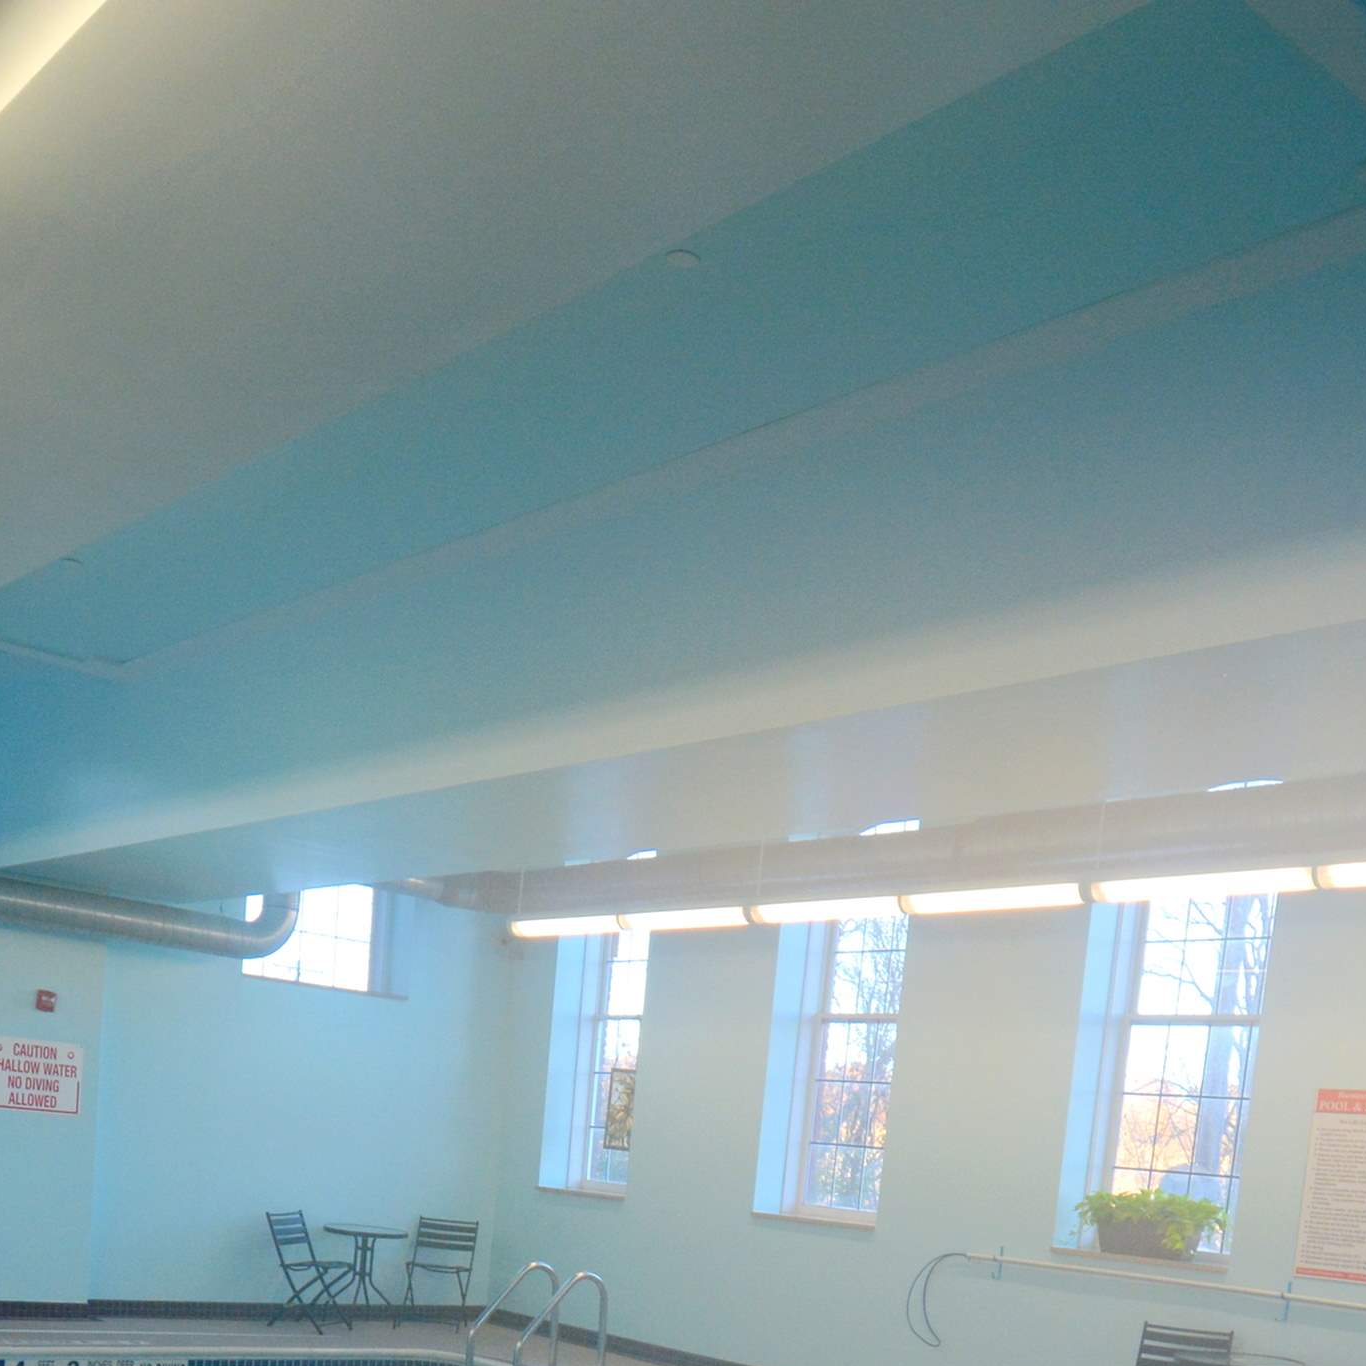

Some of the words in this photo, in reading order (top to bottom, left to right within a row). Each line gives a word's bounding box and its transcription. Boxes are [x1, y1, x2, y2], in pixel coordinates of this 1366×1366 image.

[13, 1042, 58, 1060] CAUTION
[43, 1062, 77, 1078] WATER
[7, 1075, 22, 1089] NO
[25, 1077, 60, 1092] DIVING
[8, 1092, 57, 1108] ALLOWED
[1319, 1101, 1352, 1112] POOL
[1353, 1102, 1362, 1112] &
